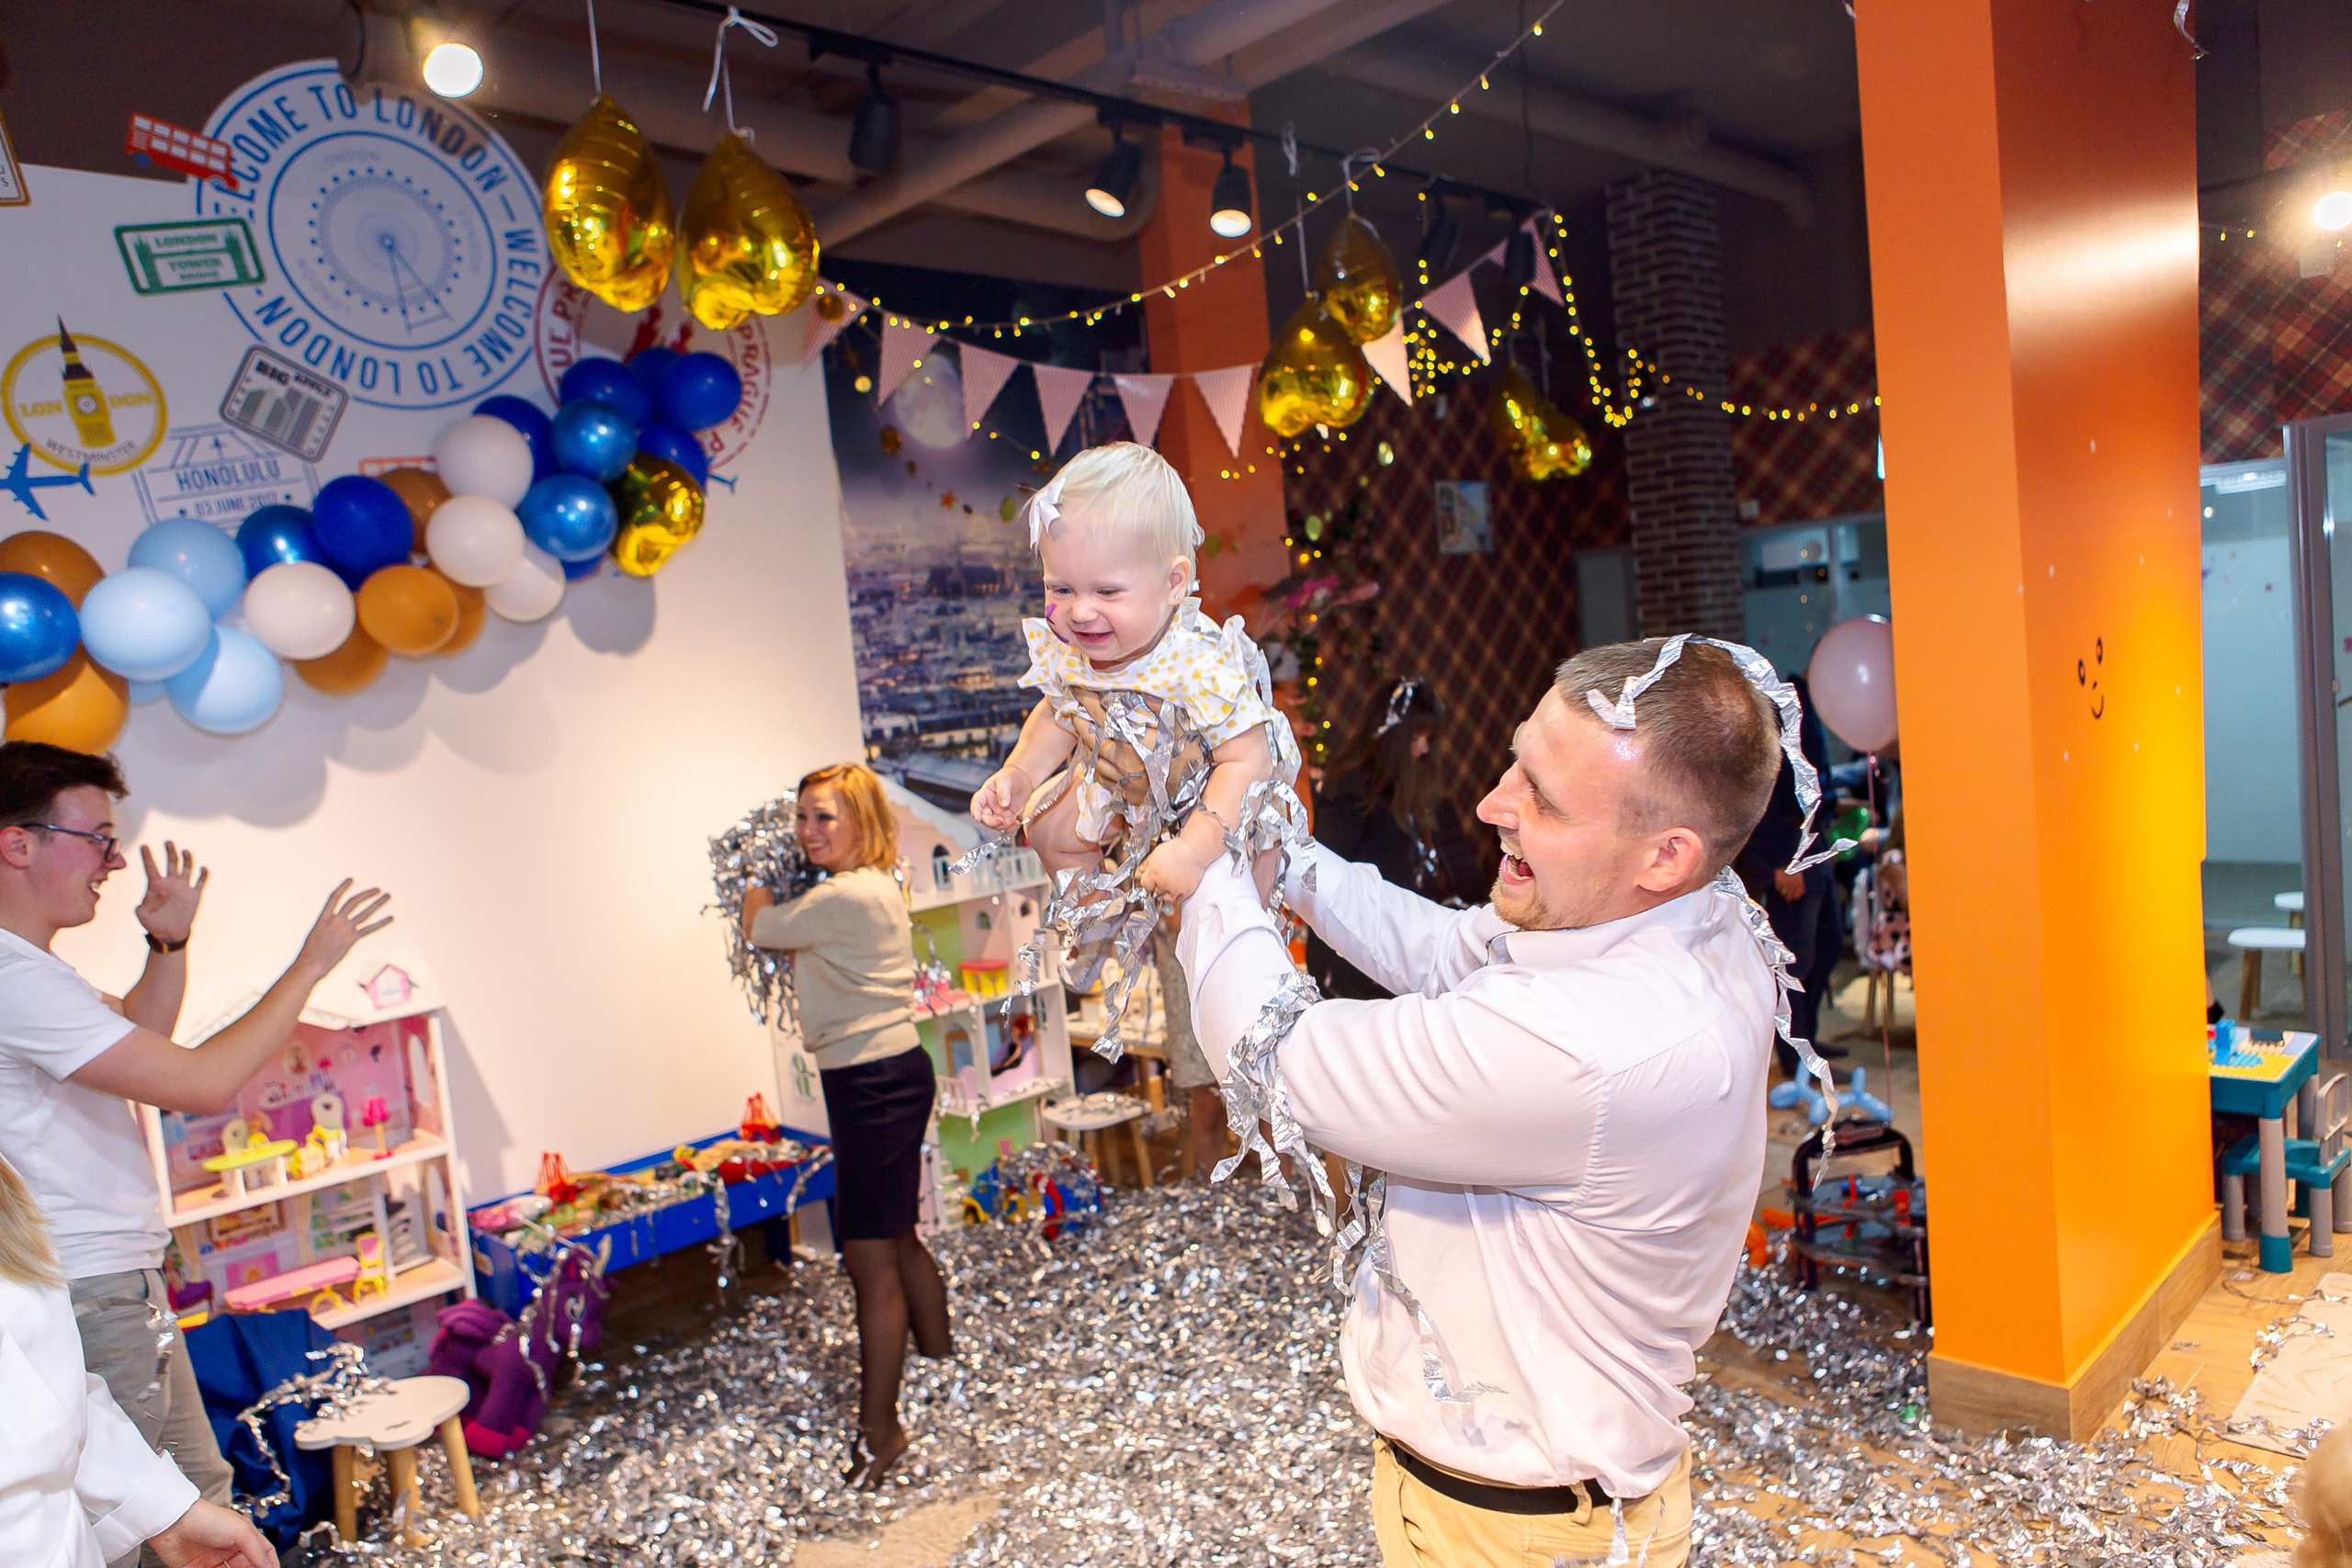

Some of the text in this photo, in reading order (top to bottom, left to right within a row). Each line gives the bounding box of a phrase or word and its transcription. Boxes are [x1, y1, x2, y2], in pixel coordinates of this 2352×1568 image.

[308, 84, 356, 121] TO
[374, 87, 507, 191] LONDON
[255, 296, 399, 395] LONDON
[463, 230, 540, 376] WELCOME
[417, 357, 463, 394] TO
[175, 459, 281, 491] HONOLULU
